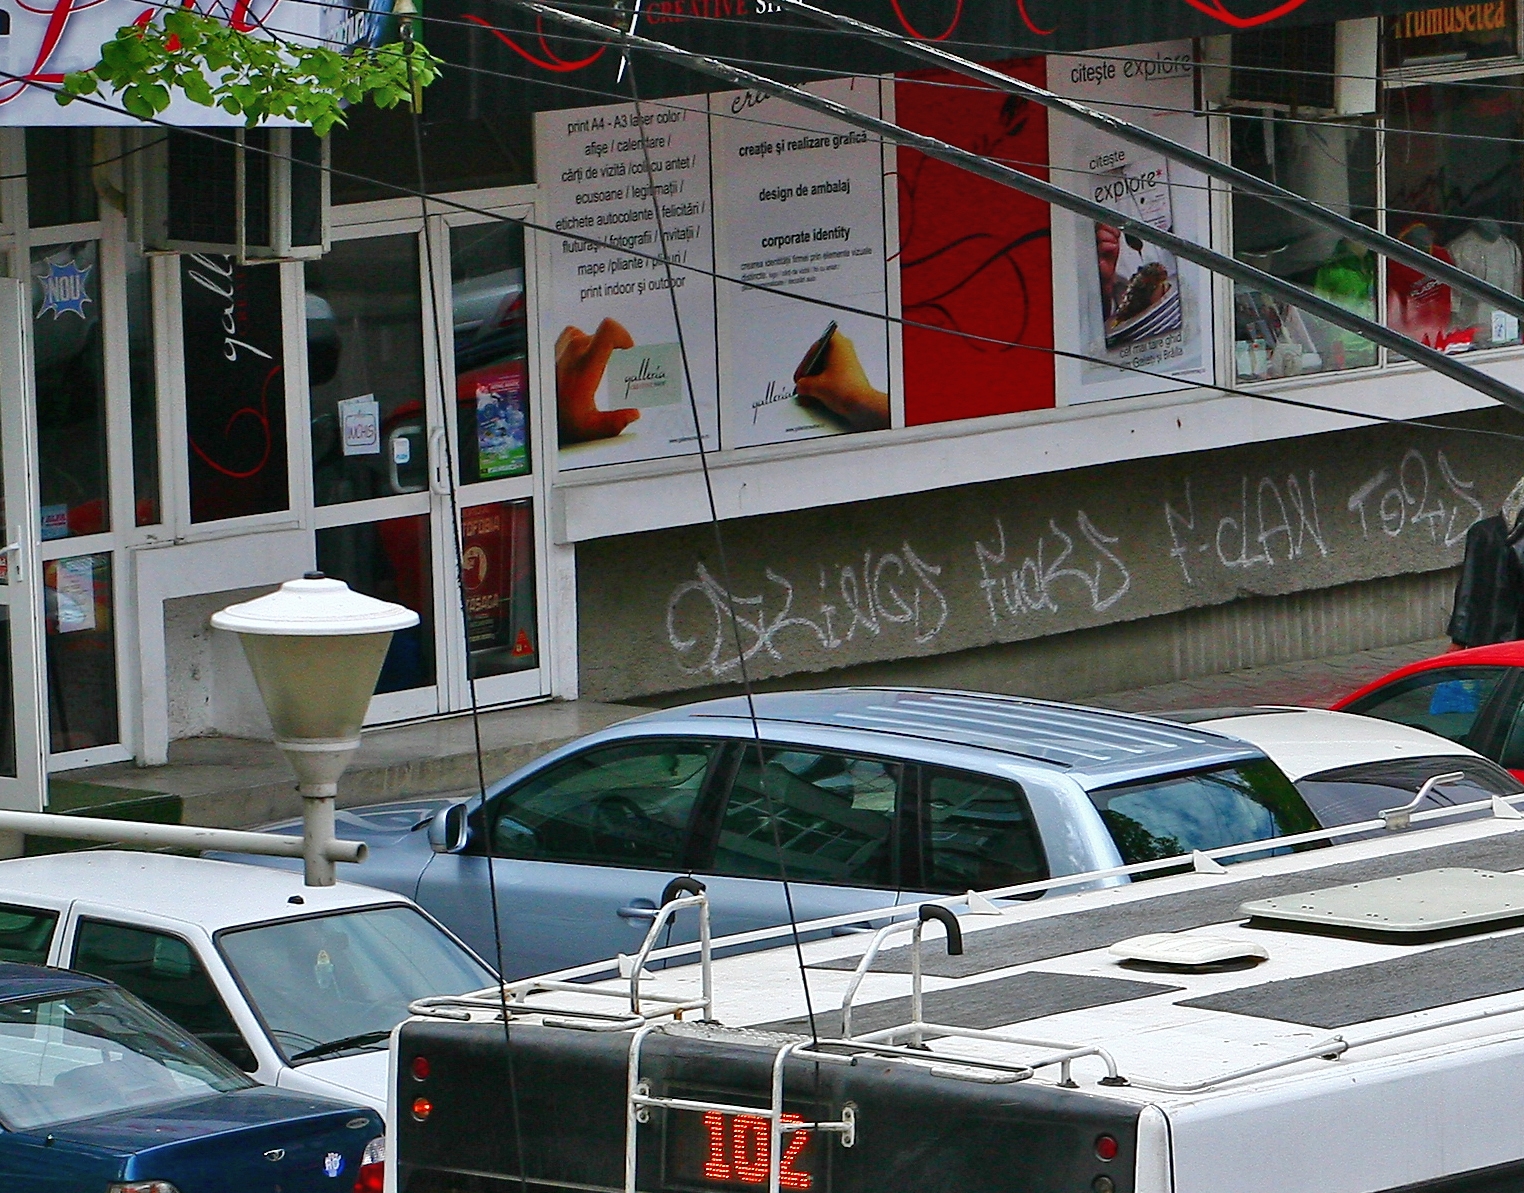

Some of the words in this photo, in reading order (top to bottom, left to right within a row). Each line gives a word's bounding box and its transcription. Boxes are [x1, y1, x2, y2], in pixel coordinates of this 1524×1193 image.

[1123, 53, 1192, 80] explore
[568, 121, 589, 137] print
[591, 119, 604, 131] A4
[613, 115, 628, 129] A3
[656, 109, 682, 125] color
[787, 136, 830, 152] realizare
[585, 166, 598, 180] de
[600, 162, 626, 178] vizită
[652, 160, 663, 172] cu
[665, 156, 692, 171] antet
[575, 188, 624, 205] ecusoane
[759, 186, 793, 202] design
[796, 183, 808, 197] de
[811, 178, 851, 196] ambalaj
[555, 215, 595, 231] etichete
[596, 208, 654, 226] autocolante
[761, 230, 810, 249] corporate
[813, 224, 851, 242] identity
[577, 260, 605, 277] mape
[47, 274, 80, 304] NOU
[580, 285, 603, 302] print
[604, 281, 636, 297] indoor
[624, 358, 666, 400] galleria
[703, 1109, 812, 1190] 102
